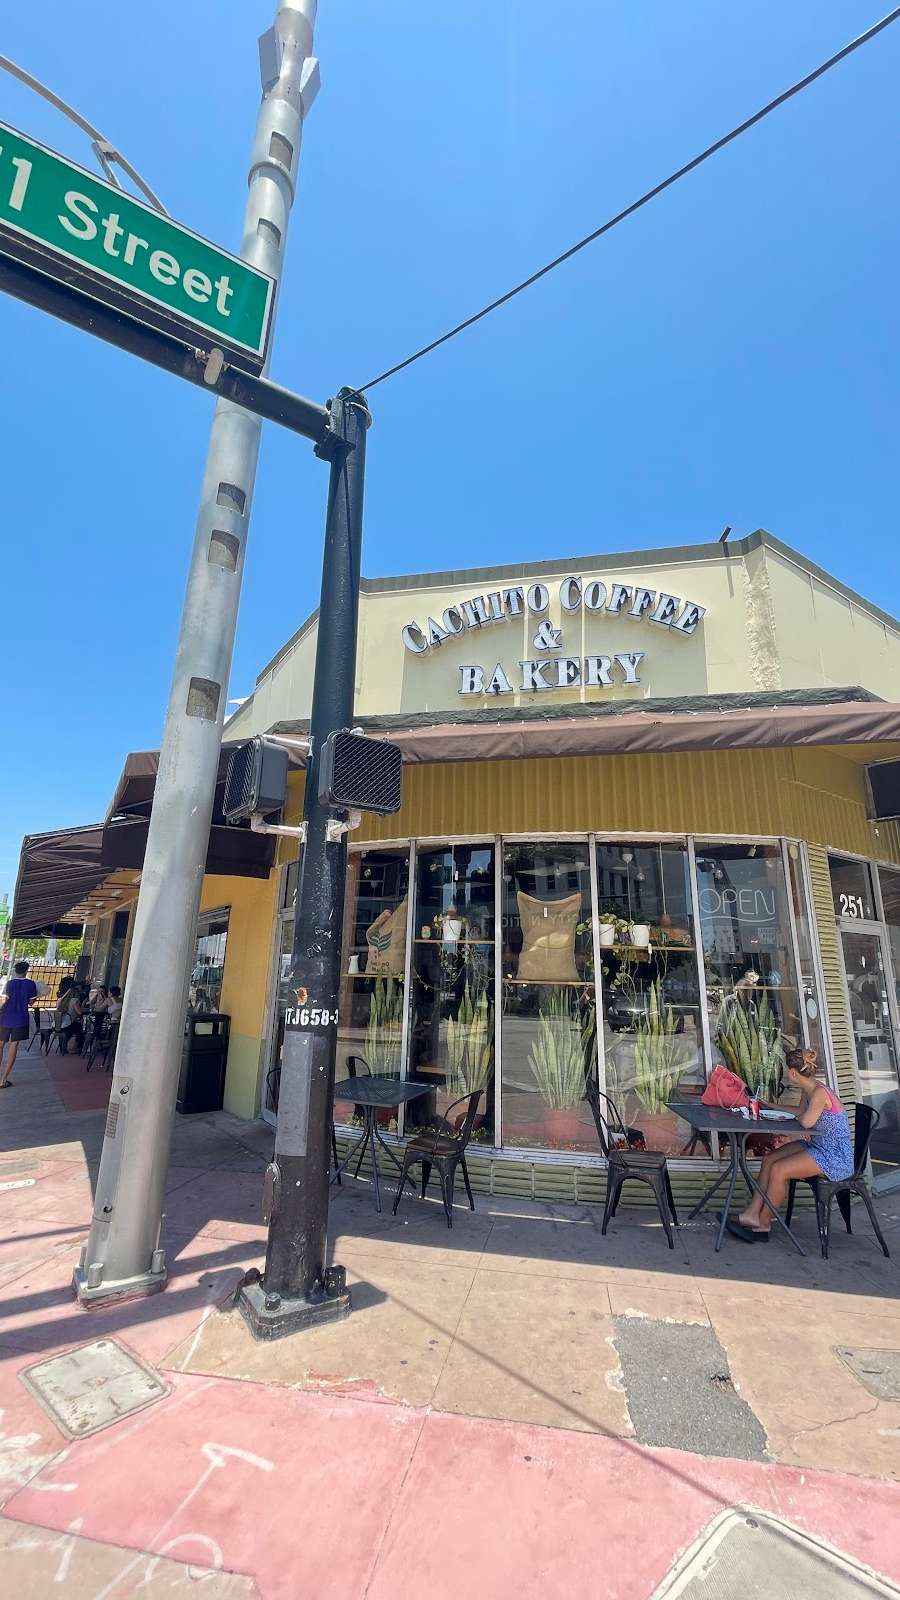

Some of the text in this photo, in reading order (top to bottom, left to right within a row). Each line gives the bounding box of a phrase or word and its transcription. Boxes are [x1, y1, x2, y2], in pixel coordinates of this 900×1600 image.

[0, 146, 234, 317] 1 Street
[401, 576, 707, 656] CACHITO COFFEE
[532, 619, 563, 651] &
[457, 652, 646, 695] BAKERY
[699, 888, 776, 916] OPEN
[839, 893, 865, 919] 251
